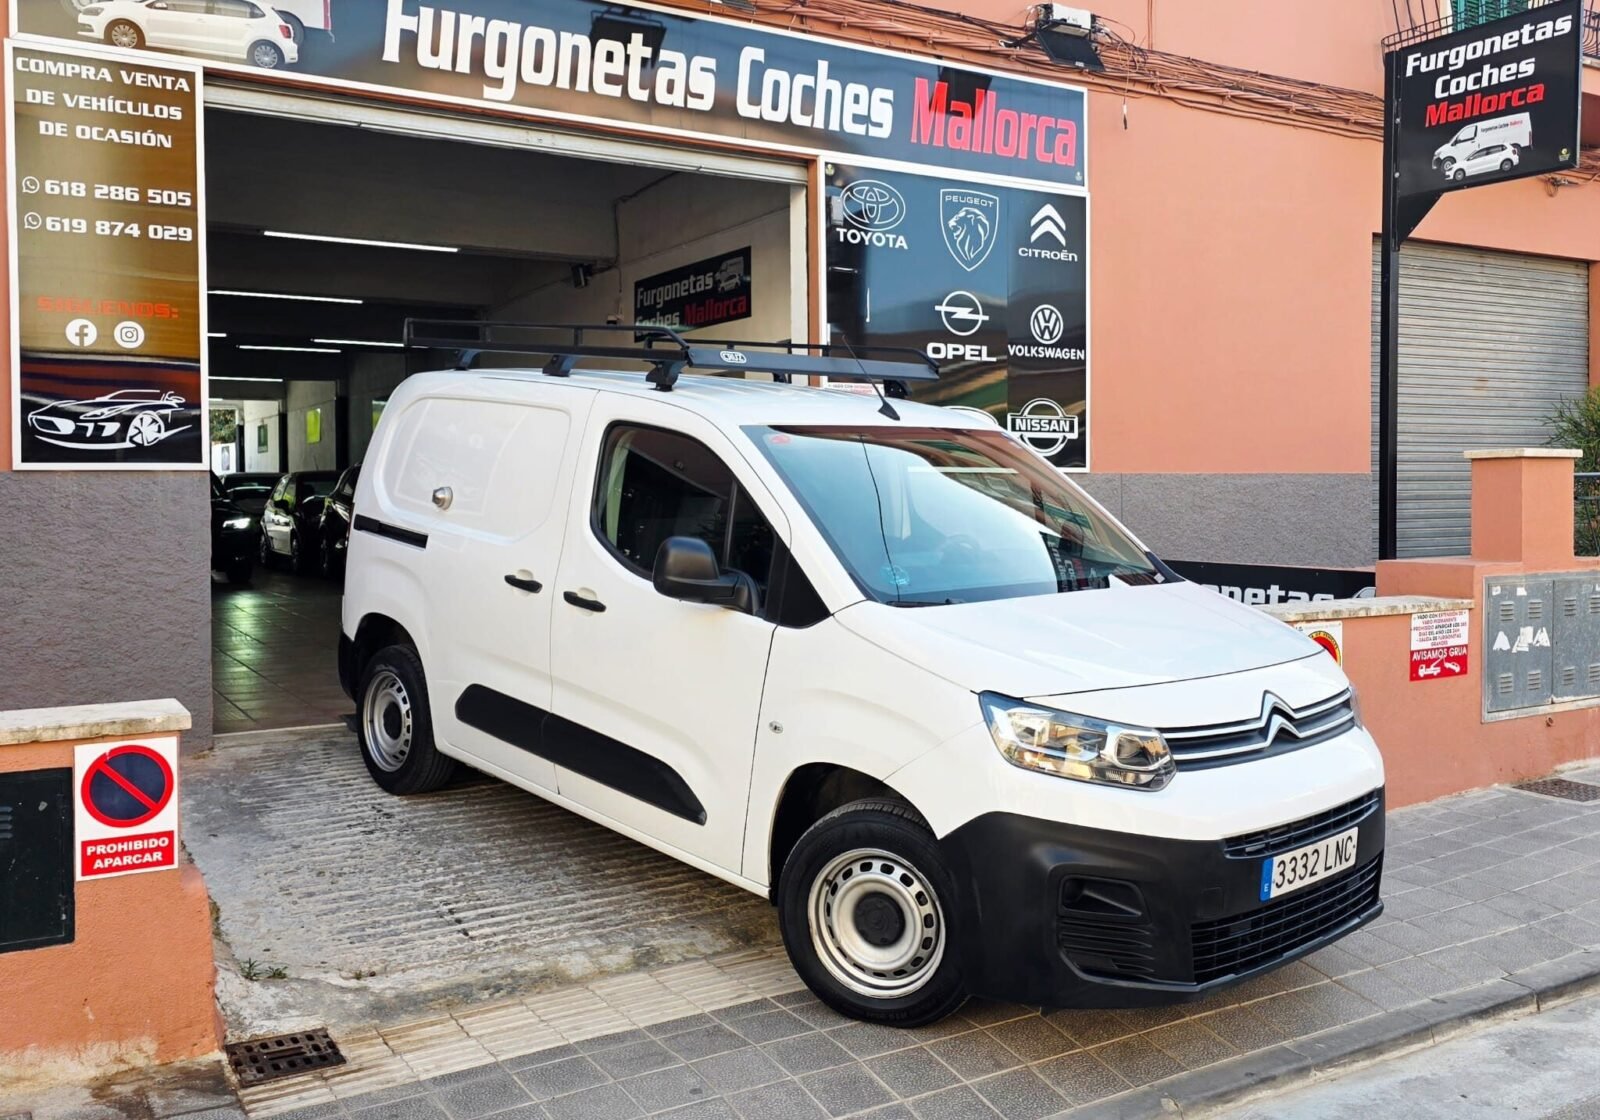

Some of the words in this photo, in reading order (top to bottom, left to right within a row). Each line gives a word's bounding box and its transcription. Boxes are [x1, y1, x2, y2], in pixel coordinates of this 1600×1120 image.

[1406, 15, 1573, 77] Furgonetas
[16, 57, 112, 82] COMPRA
[120, 70, 190, 92] VENTA
[382, 0, 717, 112] Furgonetas
[736, 46, 894, 139] Coches
[911, 77, 1077, 167] Mallorca
[1434, 58, 1535, 99] Coches
[26, 88, 55, 105] DE
[63, 91, 183, 121] VEHÍCULOS
[1425, 83, 1545, 127] Mallorca
[39, 121, 68, 137] DE
[75, 124, 173, 149] OCASIÓN
[44, 180, 86, 198] 618
[94, 184, 139, 202] 286
[147, 189, 192, 207] 505
[945, 195, 995, 209] PEUGEOT
[46, 216, 87, 234] 619
[95, 220, 140, 239] 874
[148, 223, 193, 242] 029
[836, 227, 909, 250] TOYOTA
[637, 271, 714, 310] Furgonetas
[684, 295, 747, 326] Mallorca
[926, 342, 997, 362] OPEL
[1008, 344, 1085, 360] VOLKSWAGEN
[1016, 418, 1070, 433] NISSAN
[1412, 648, 1448, 661] AVISAMOS
[1449, 646, 1467, 657] GRUA
[87, 837, 169, 856] PROHIBIDO
[93, 852, 162, 869] APARCAR
[1275, 848, 1320, 889] 3332
[1324, 835, 1353, 872] LNC
